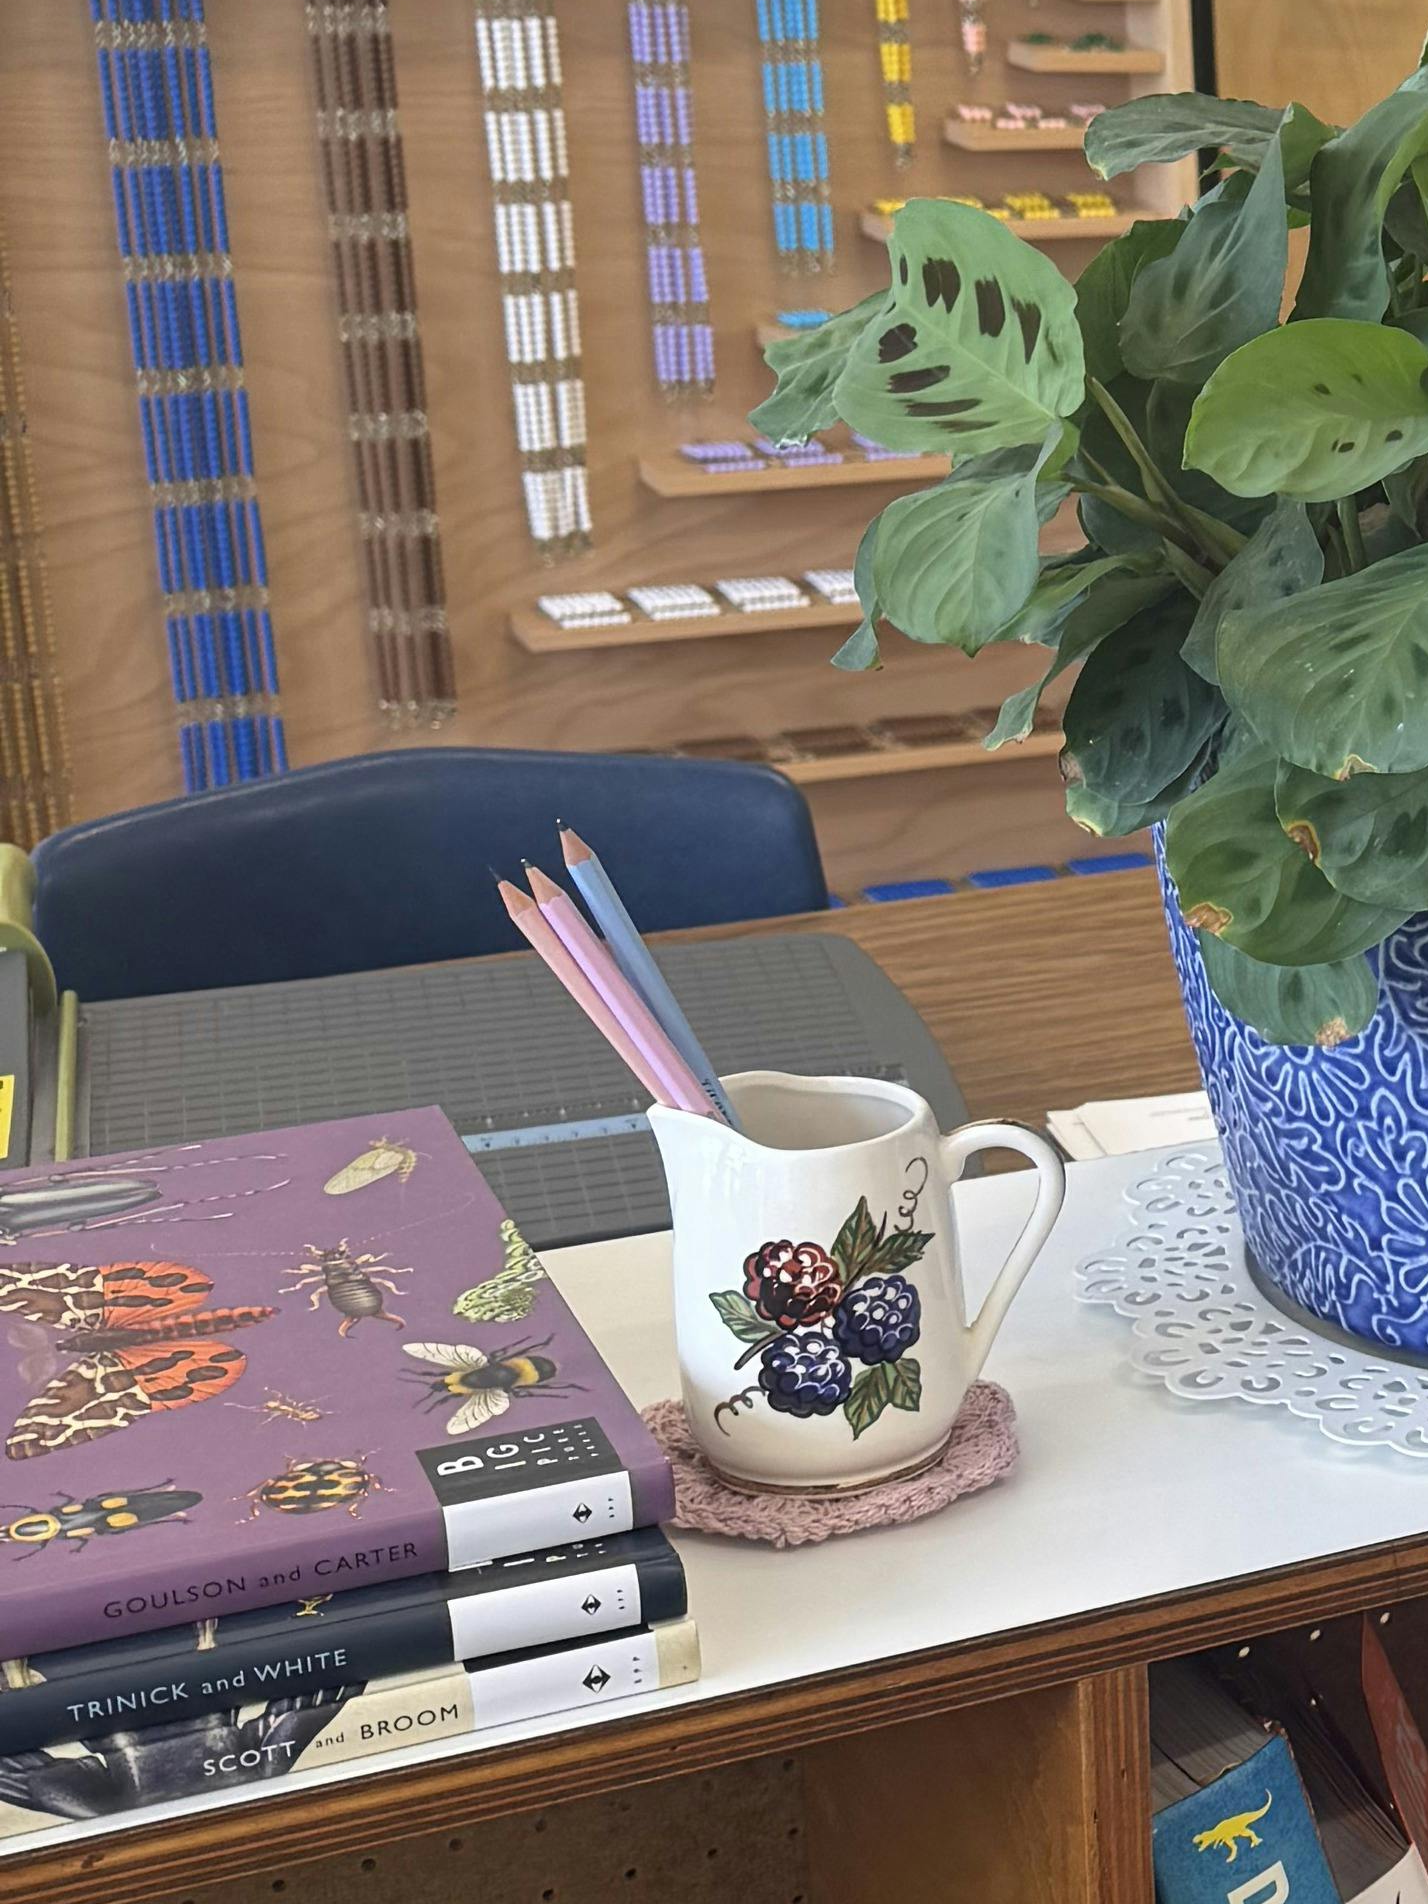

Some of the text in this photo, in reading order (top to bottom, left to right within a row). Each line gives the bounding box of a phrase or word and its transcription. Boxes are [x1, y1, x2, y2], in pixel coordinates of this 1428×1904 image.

[104, 1542, 418, 1619] GOULSON and CARTER
[67, 1648, 348, 1722] TRINICK and WHITE
[203, 1703, 459, 1777] SCOTT and BROOM
